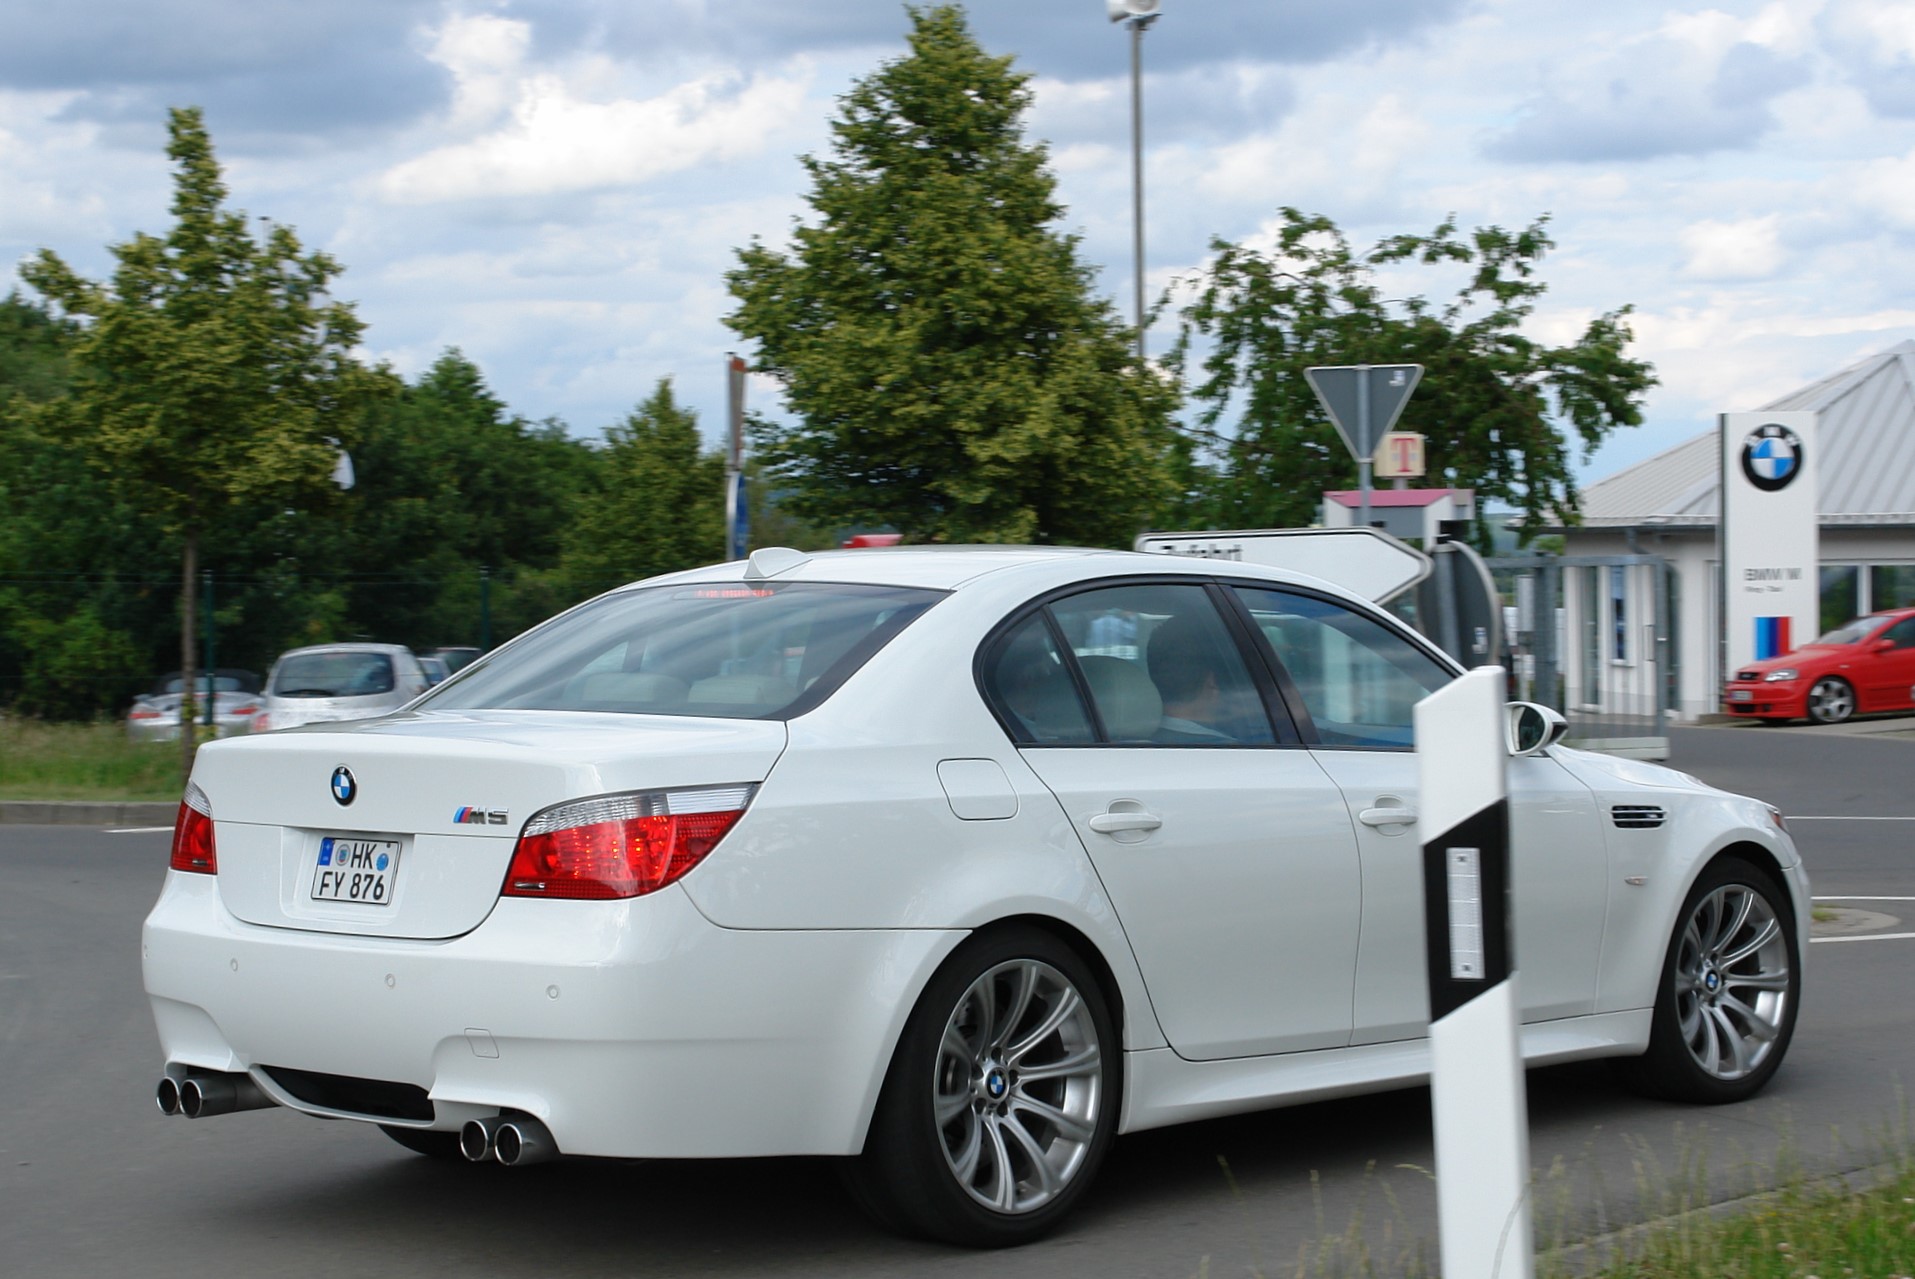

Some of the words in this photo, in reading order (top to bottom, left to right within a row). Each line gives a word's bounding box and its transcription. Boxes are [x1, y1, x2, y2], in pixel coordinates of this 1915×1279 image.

[464, 806, 509, 825] M5
[350, 842, 377, 869] HK
[319, 871, 346, 897] FY
[350, 873, 385, 900] 876
